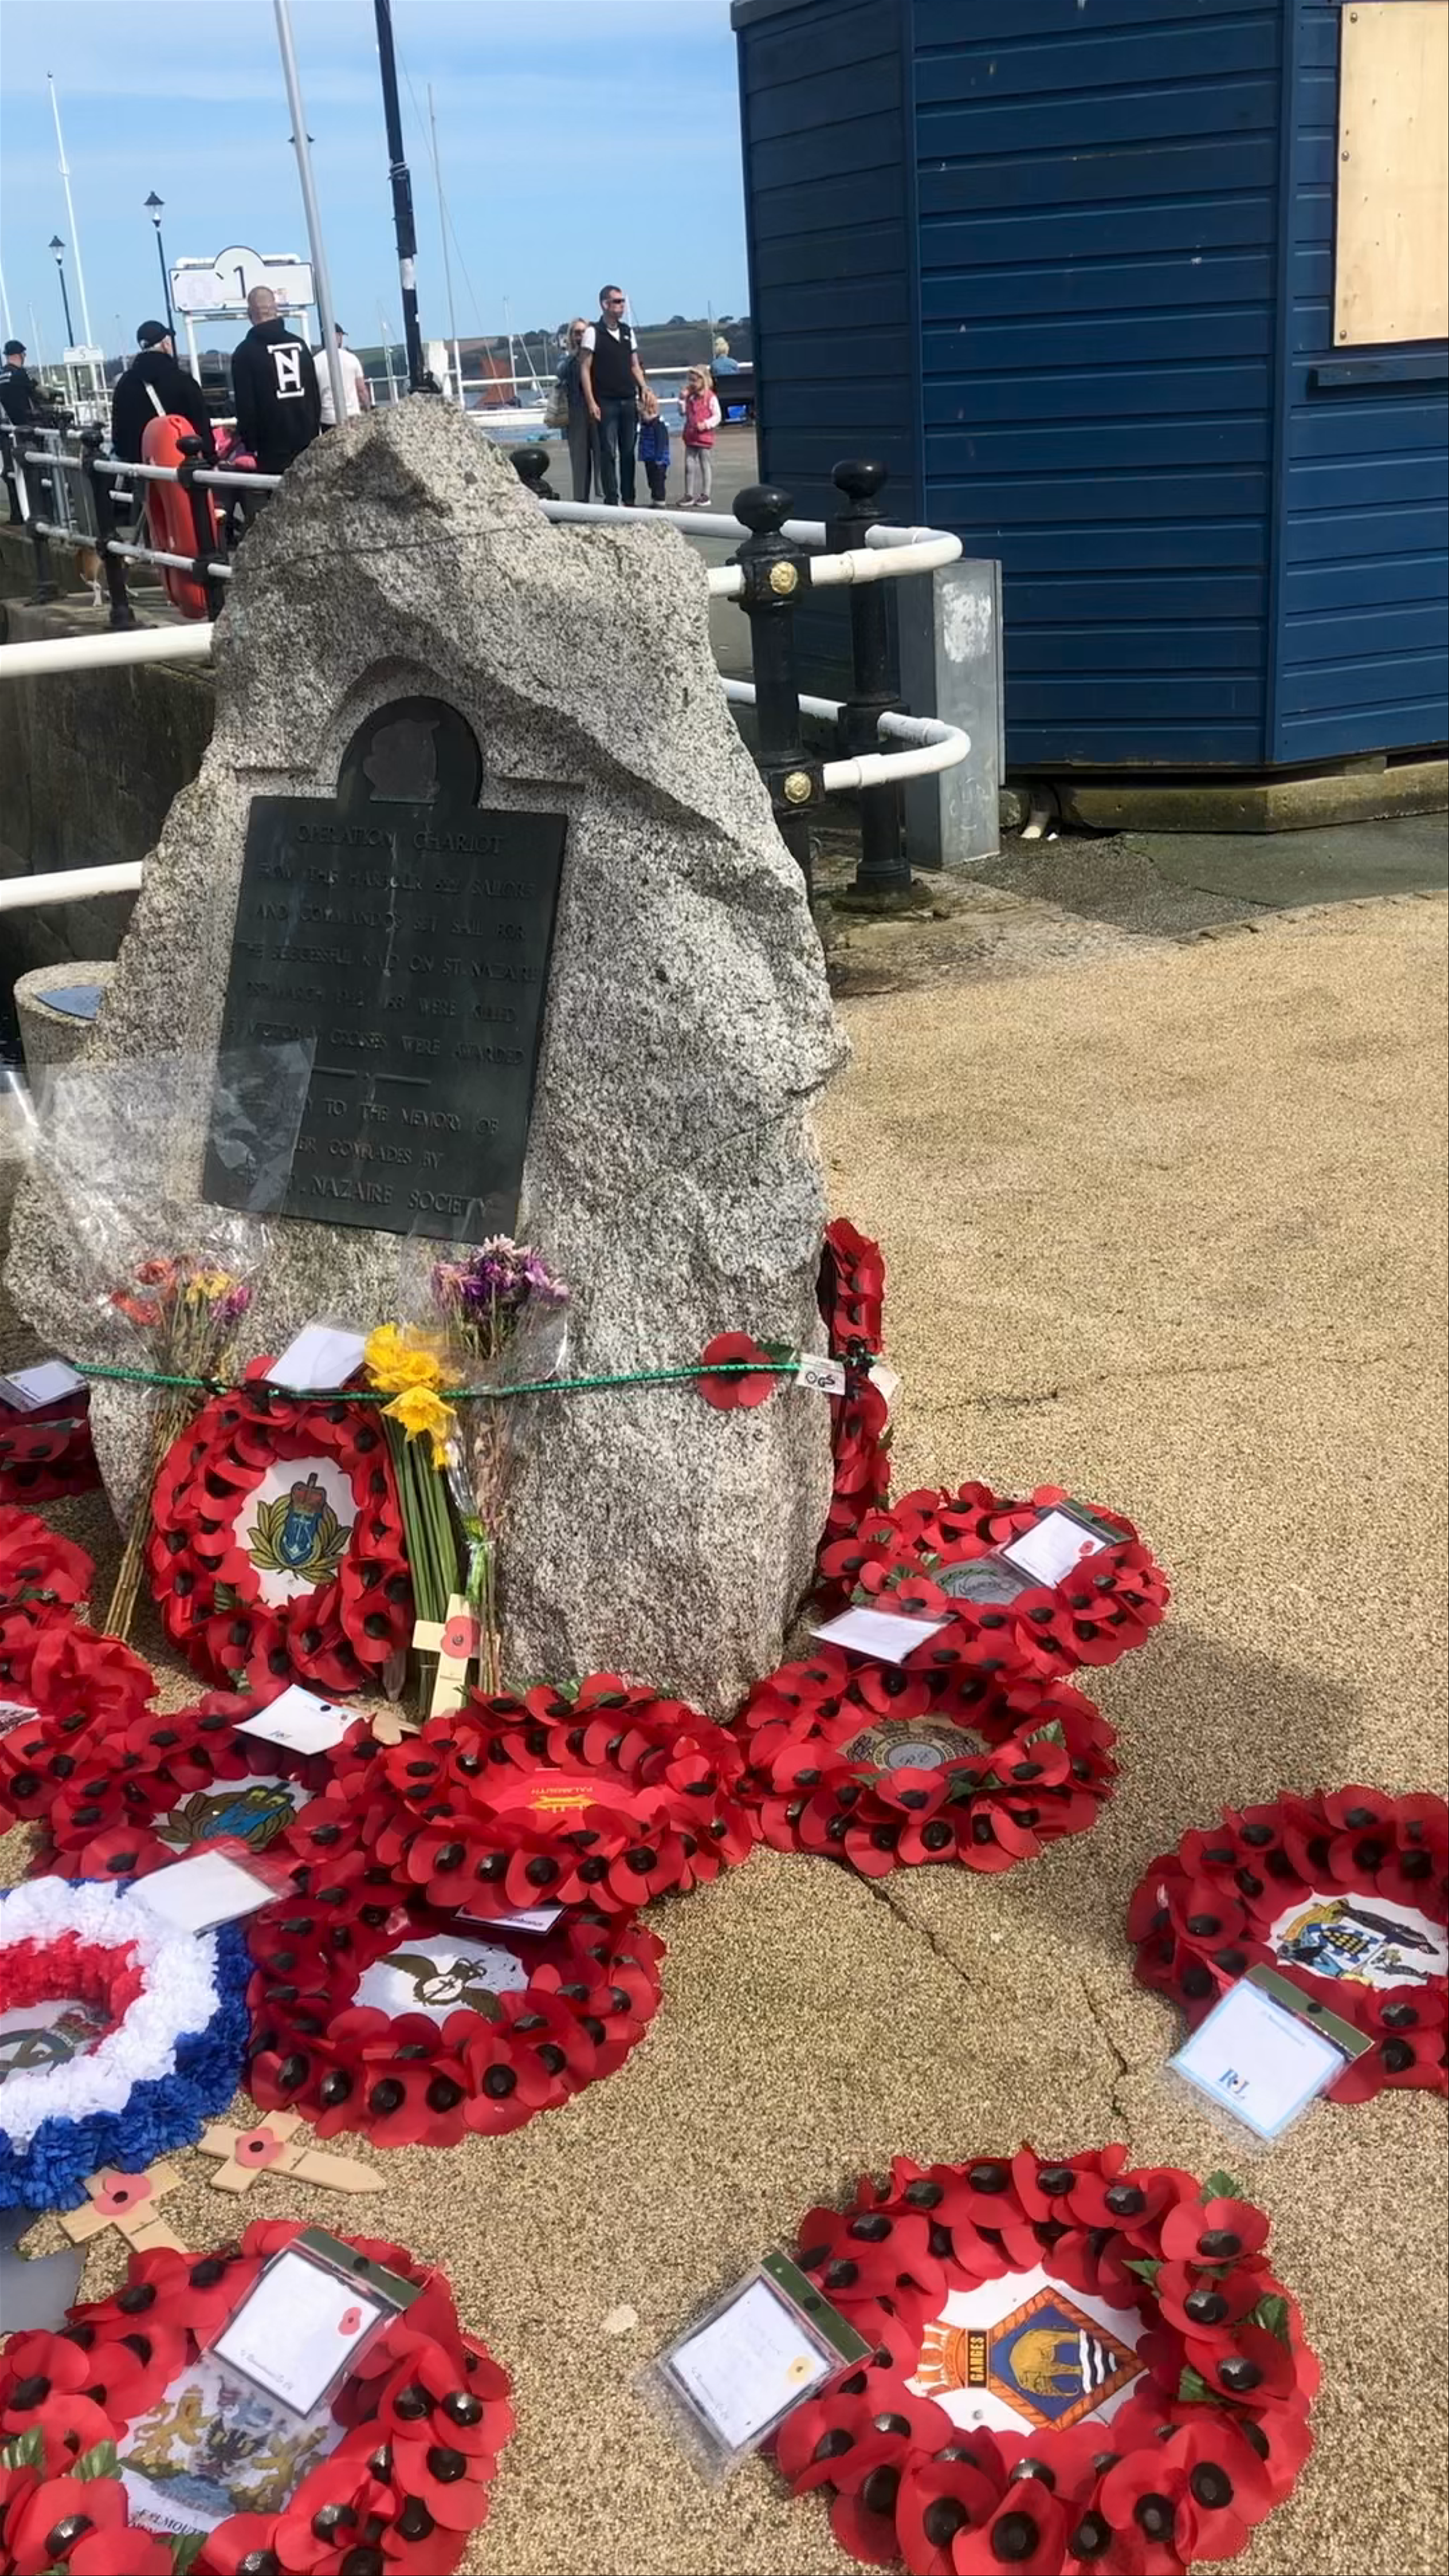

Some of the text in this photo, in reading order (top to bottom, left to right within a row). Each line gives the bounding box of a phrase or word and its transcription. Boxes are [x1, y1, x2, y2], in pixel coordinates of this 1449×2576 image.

[234, 265, 246, 299] 1
[414, 830, 503, 854] CHARIOT
[409, 954, 434, 973] ON
[401, 1035, 441, 1057] WERE
[323, 1097, 348, 1117] TO
[401, 1107, 461, 1132] MEMORY
[328, 1138, 412, 1166] COMRADES
[311, 1174, 394, 1206] NAZAIRE
[970, 2336, 984, 2381] GANGES
